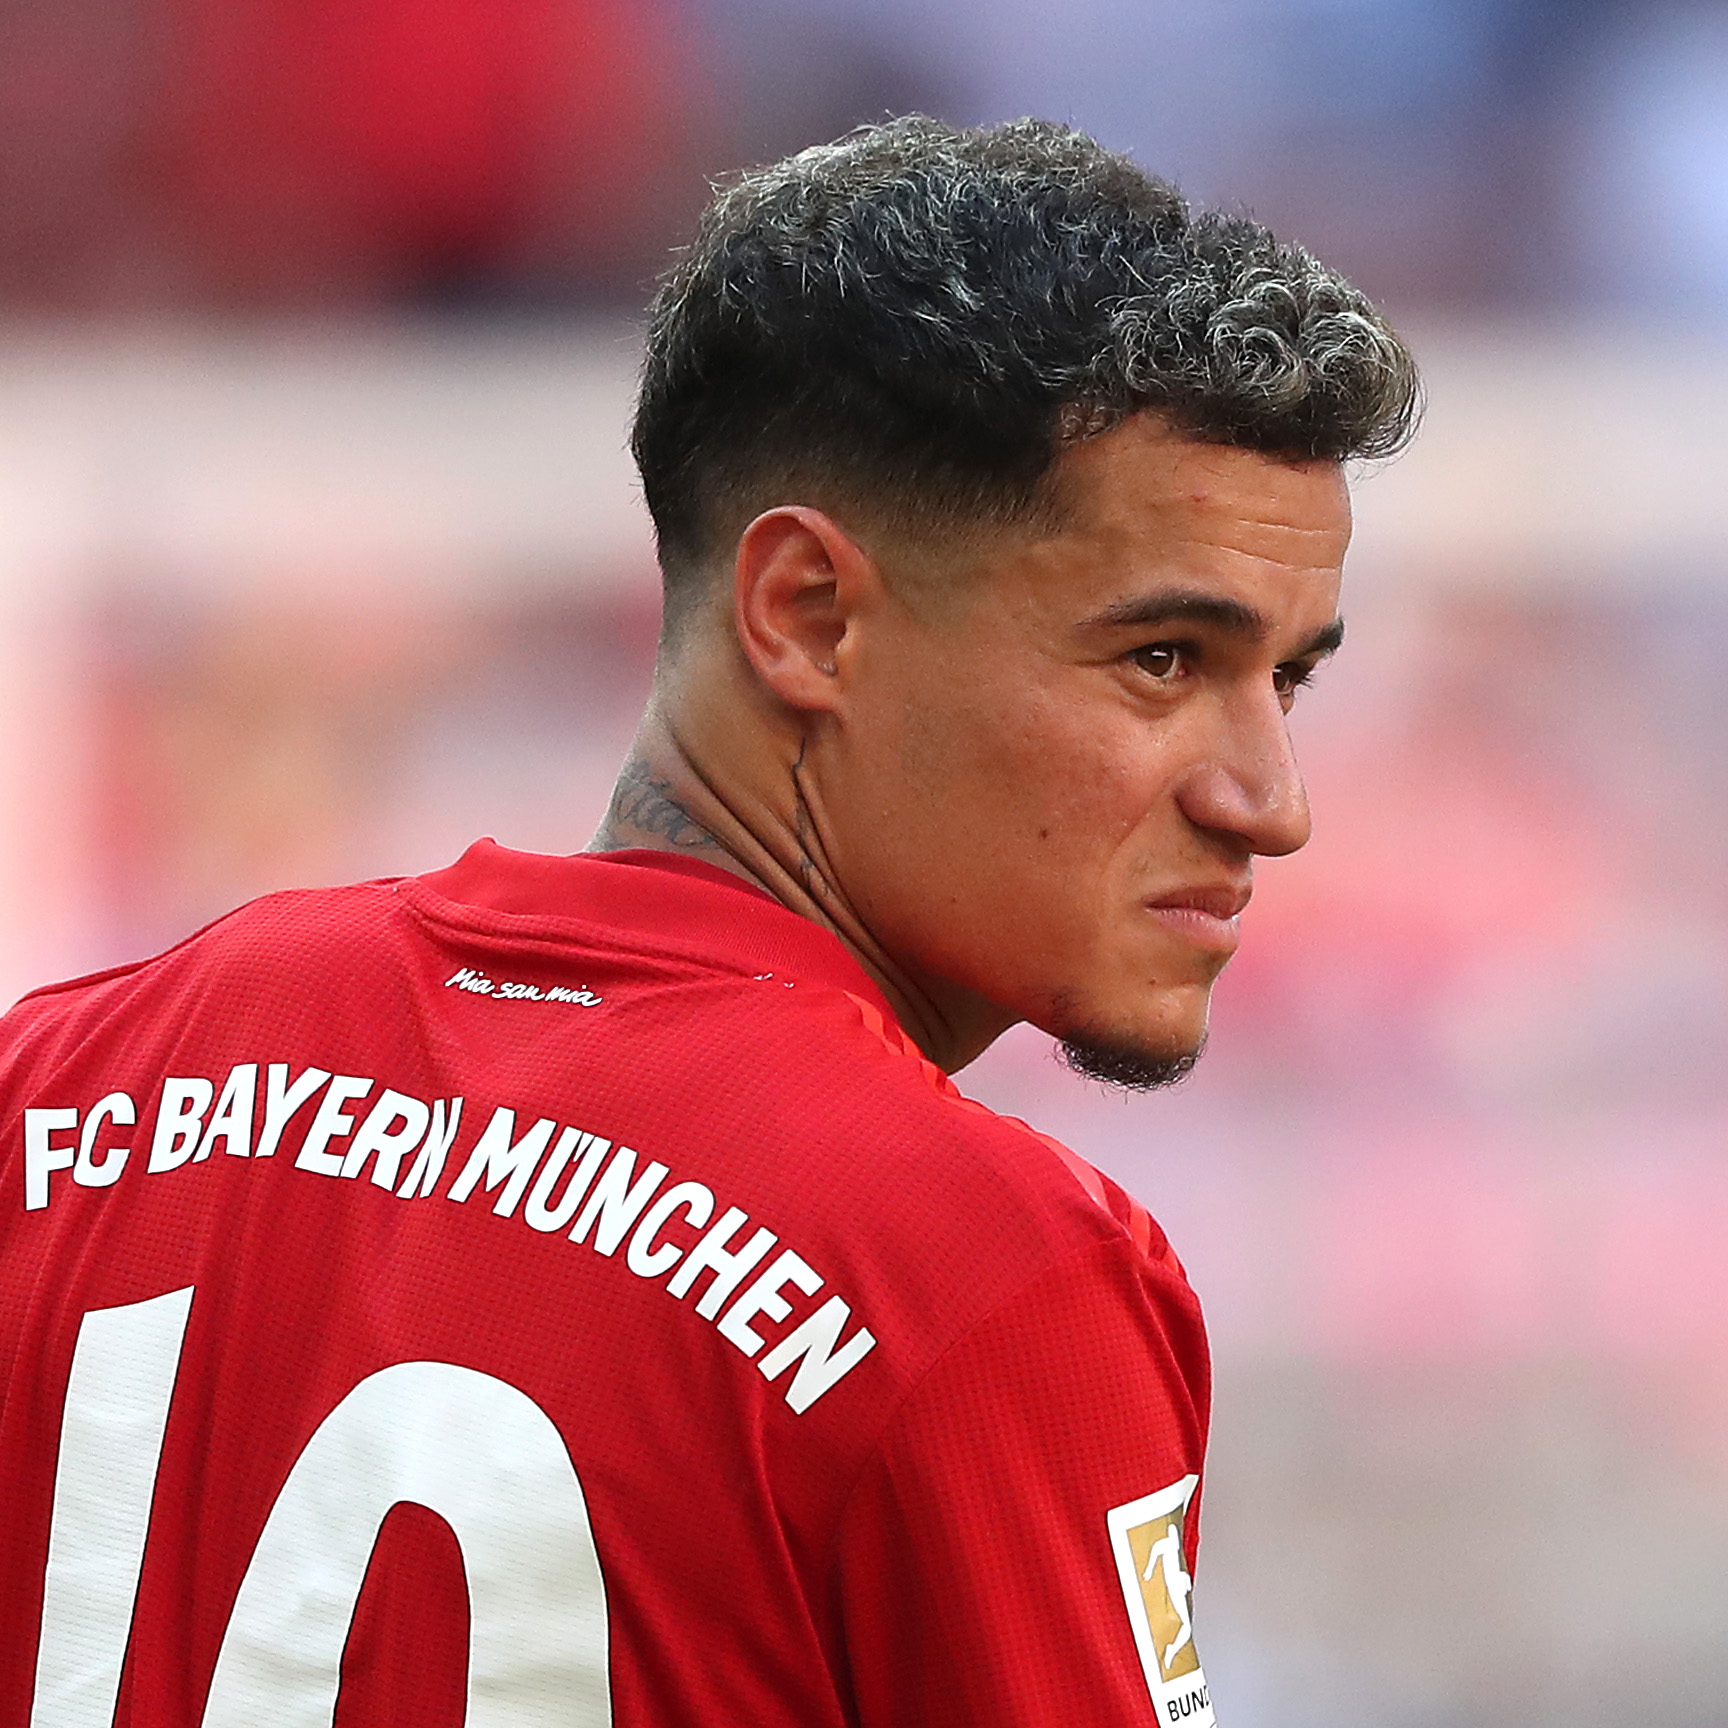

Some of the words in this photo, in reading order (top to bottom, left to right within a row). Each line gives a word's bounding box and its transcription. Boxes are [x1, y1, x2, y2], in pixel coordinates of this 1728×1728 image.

[445, 967, 495, 994] Mia
[491, 982, 546, 1001] san
[544, 984, 603, 1007] mia
[24, 1091, 136, 1211] FC
[146, 1062, 464, 1199] BAYERN
[447, 1105, 877, 1416] MÜNCHEN
